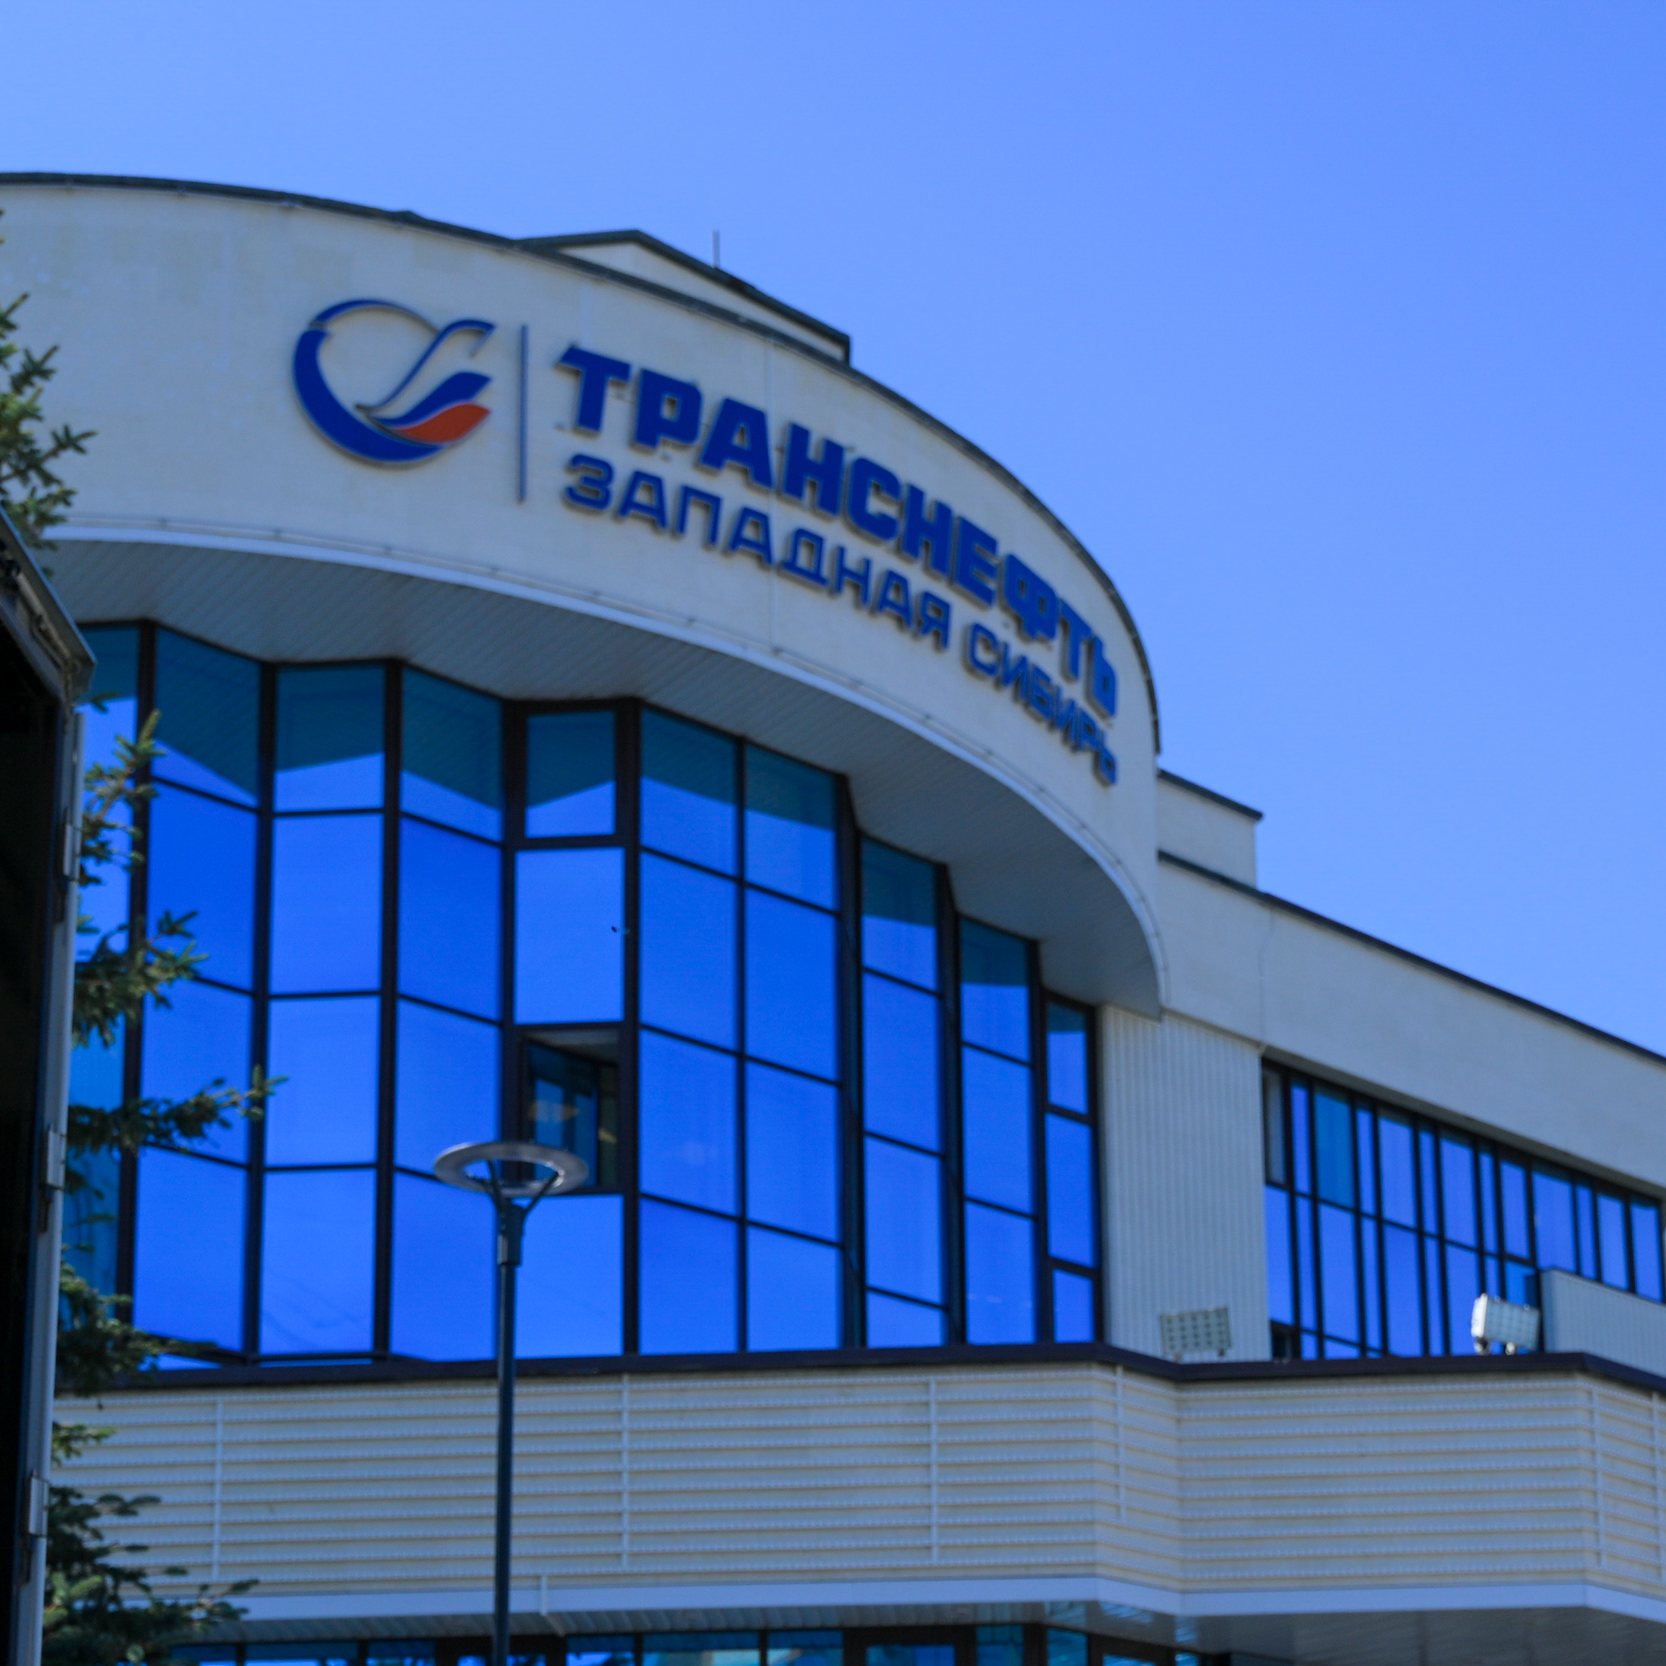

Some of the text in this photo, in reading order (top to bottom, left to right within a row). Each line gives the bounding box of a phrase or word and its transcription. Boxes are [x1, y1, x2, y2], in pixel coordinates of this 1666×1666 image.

[555, 345, 1118, 718] ТРАНСНЕФТЬ
[561, 454, 1118, 785] ЗАПАДНАЯ СИБИРЬ
